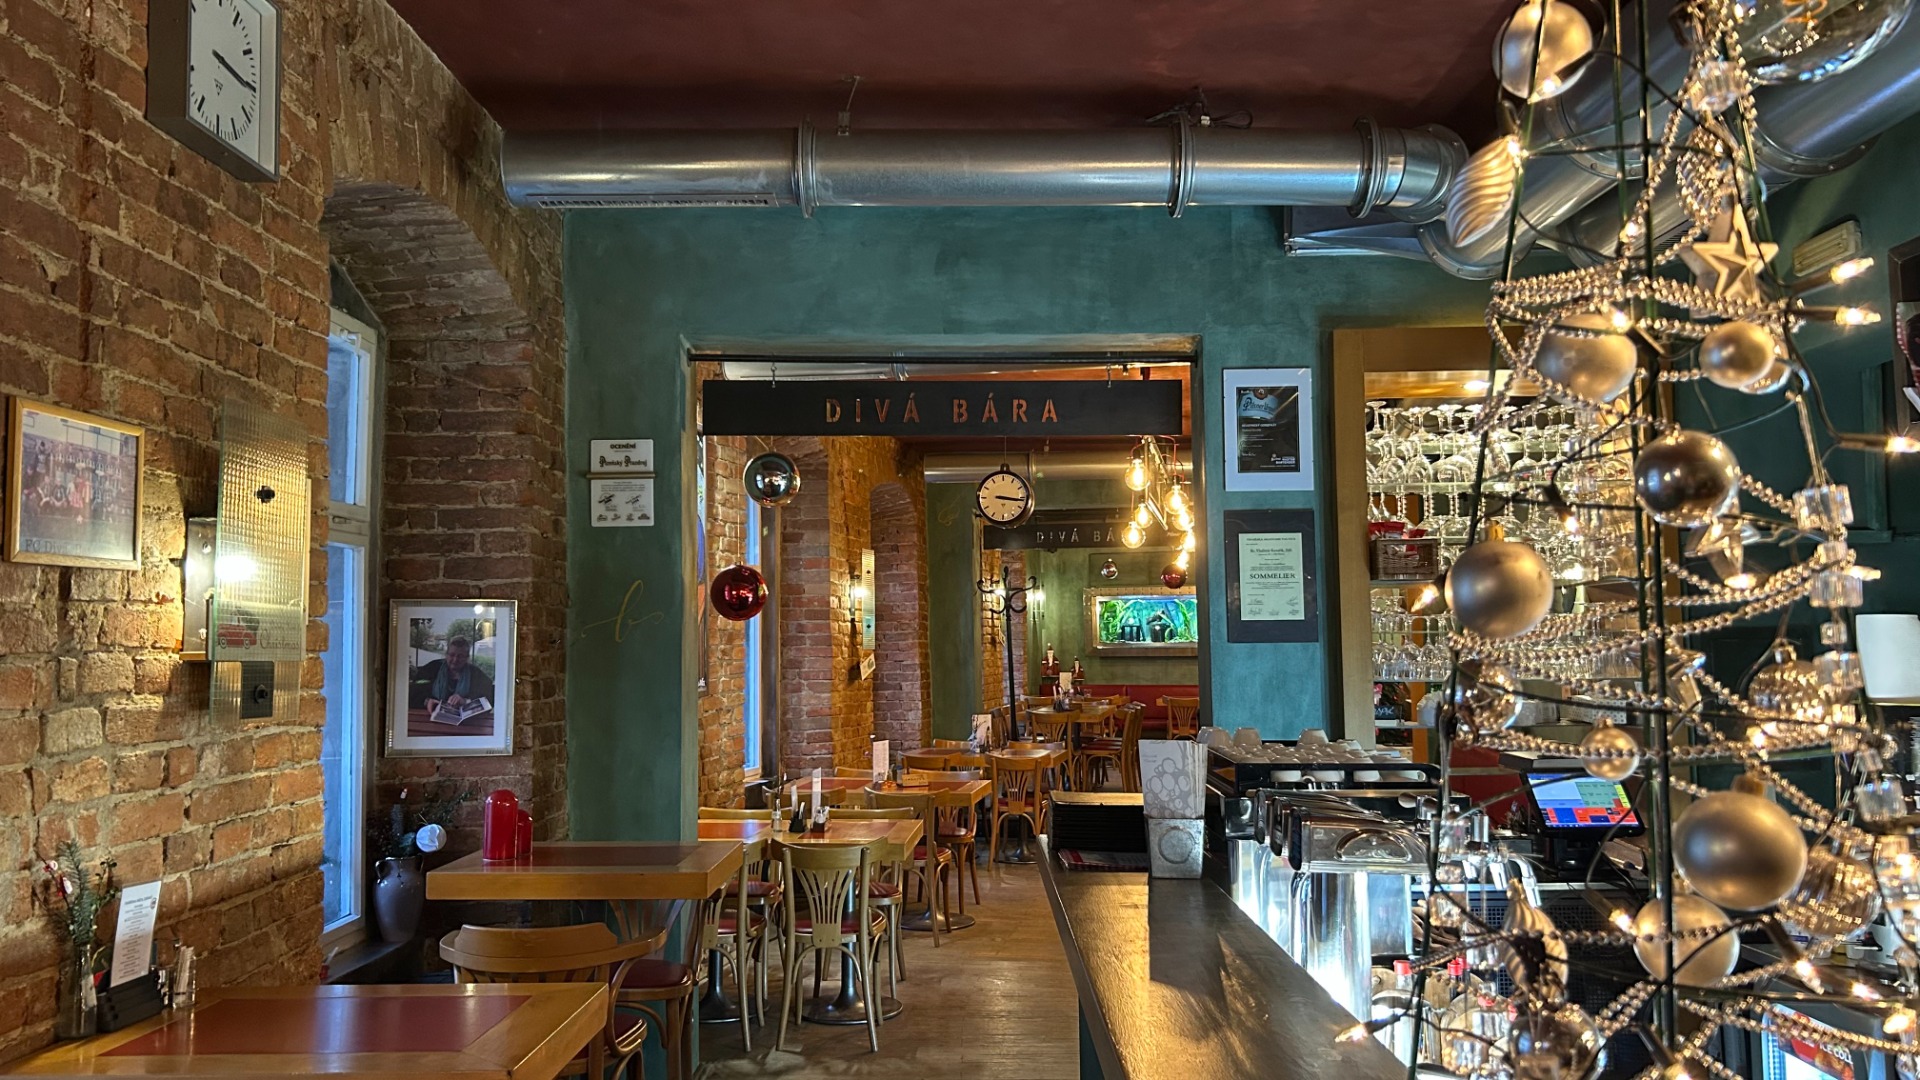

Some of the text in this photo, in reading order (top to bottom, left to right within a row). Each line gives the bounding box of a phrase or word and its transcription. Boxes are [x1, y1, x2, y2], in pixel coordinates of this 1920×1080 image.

[825, 392, 1058, 423] DIVÁ BÁRA
[1093, 528, 1116, 542] BÁ
